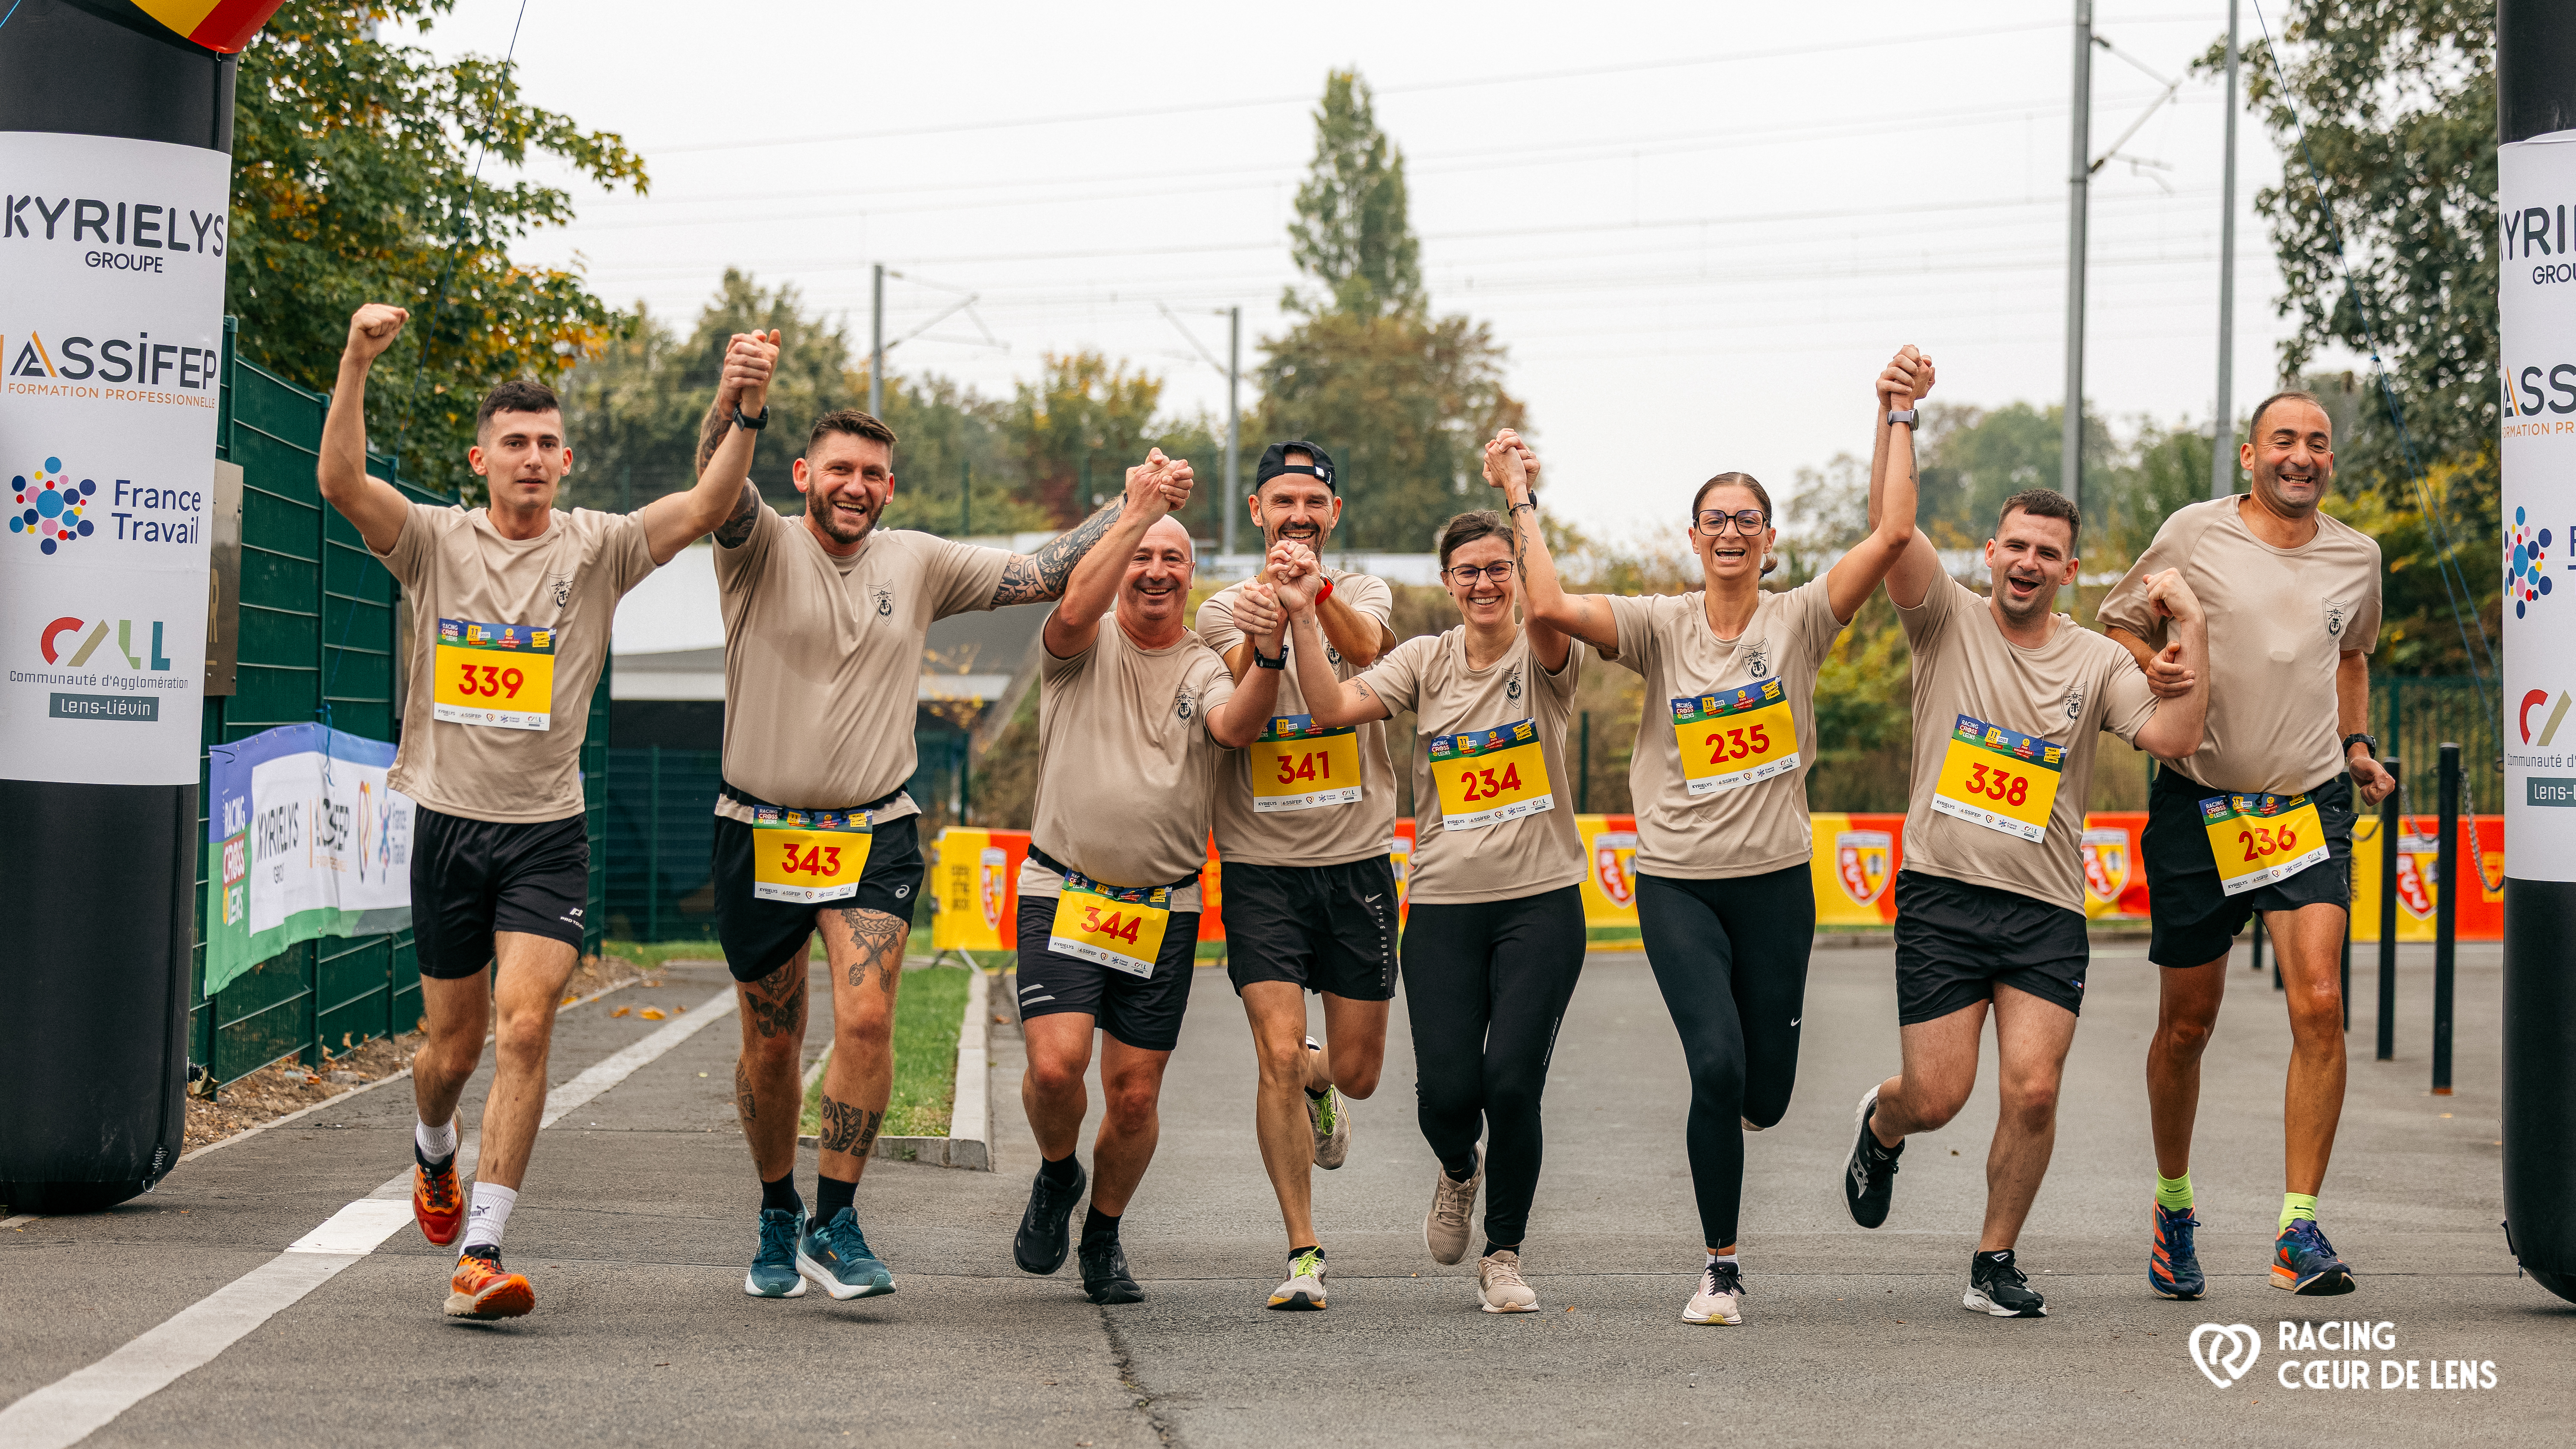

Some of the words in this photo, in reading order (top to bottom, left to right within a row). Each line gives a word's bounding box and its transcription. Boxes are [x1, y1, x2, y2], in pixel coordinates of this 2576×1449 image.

[3, 195, 223, 257] KYRIELYS
[85, 251, 163, 273] GROUPE
[9, 383, 99, 398] FORMATION
[106, 389, 215, 409] PROFESSIONNELLE
[115, 479, 201, 512] France
[111, 513, 199, 544] Travail
[10, 671, 97, 686] Communauté
[102, 675, 188, 690] d'Agglomération
[459, 664, 524, 699] 339
[61, 699, 150, 716] Lens-Liévin
[1959, 725, 1978, 735] CROSS
[1961, 720, 1979, 729] RACING
[1962, 732, 1975, 740] LENS
[1990, 730, 1998, 738] 11
[1706, 724, 1770, 764] 235
[1277, 751, 1329, 784] 341
[1461, 762, 1522, 802] 234
[1966, 762, 2028, 806] 338
[224, 795, 245, 838] RACING
[1936, 800, 1956, 809] KYRIELYS
[2205, 800, 2224, 809] RACING
[2207, 805, 2226, 814] CROSS
[2239, 824, 2297, 862] 236
[782, 843, 841, 877] 343
[2228, 881, 2248, 889] KYRIELYS
[1081, 906, 1142, 945] 344
[1375, 905, 1385, 929] NIKE
[1380, 936, 1388, 987] RUNNING
